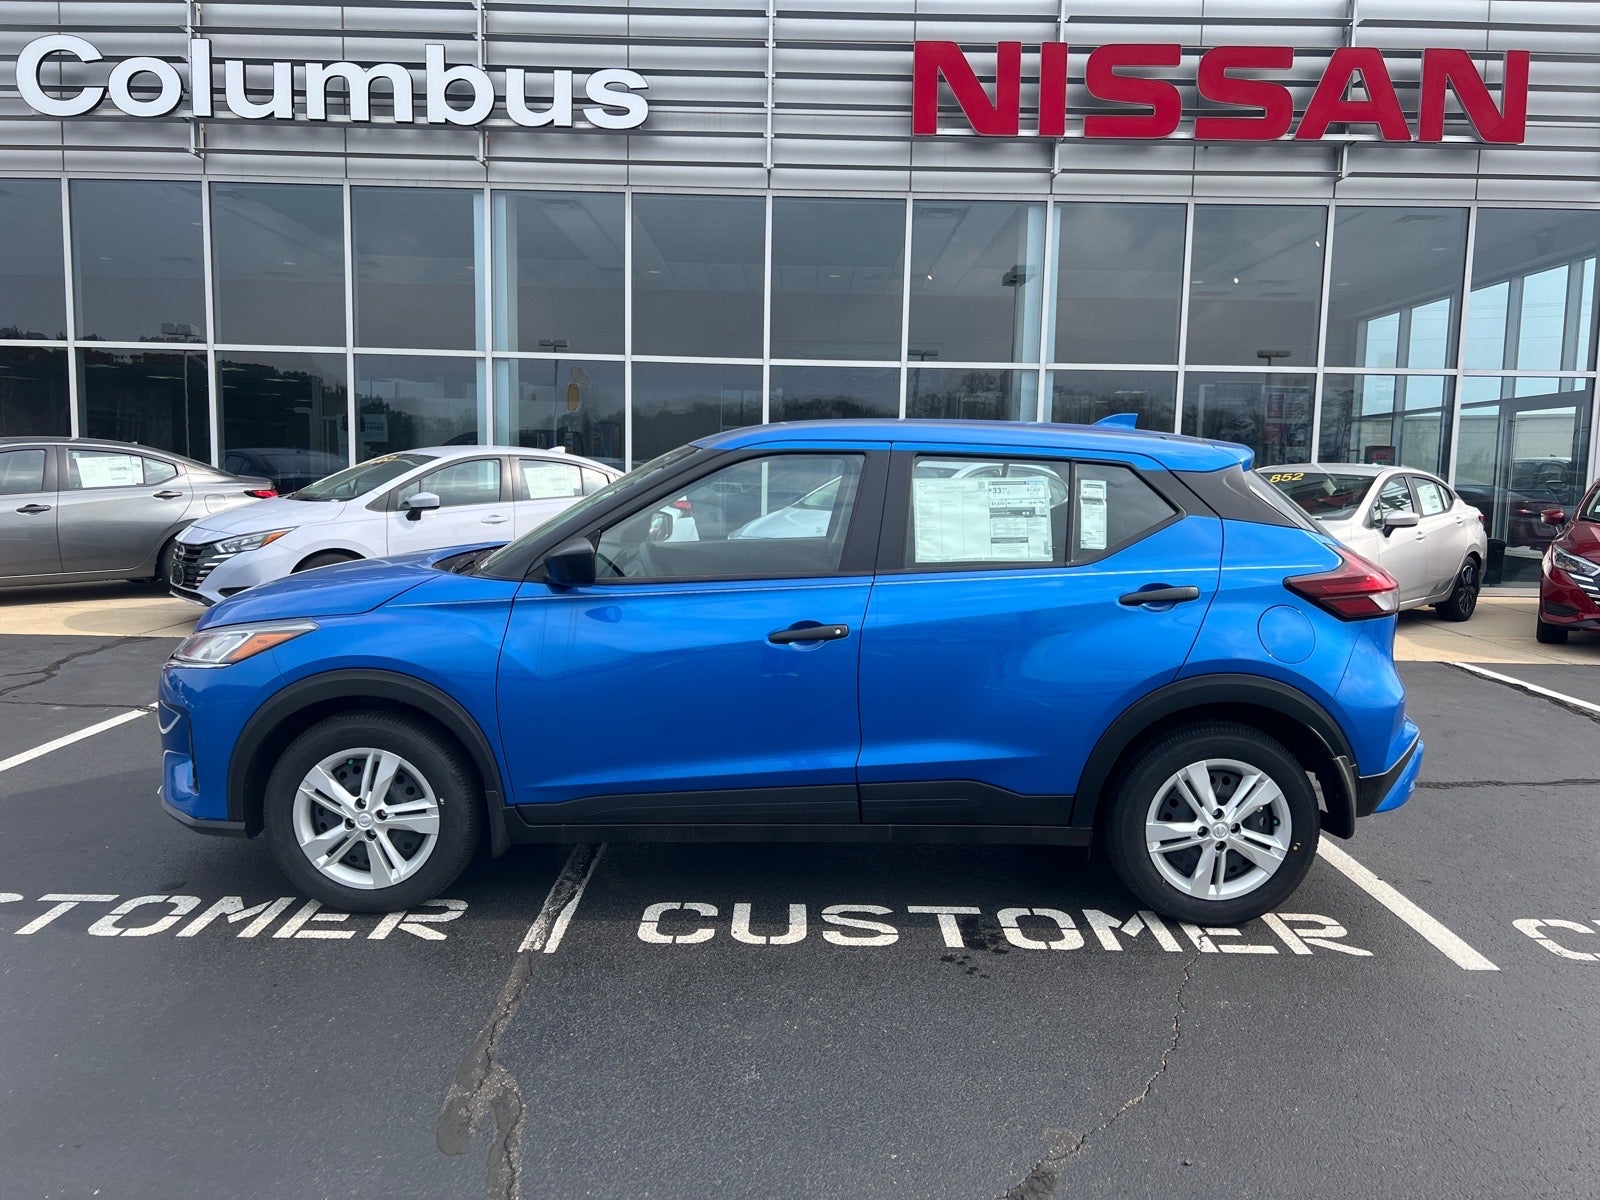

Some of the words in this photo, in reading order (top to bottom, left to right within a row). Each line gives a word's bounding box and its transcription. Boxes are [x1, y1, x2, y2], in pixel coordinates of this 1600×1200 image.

[16, 34, 649, 130] Columbus
[912, 41, 1530, 144] NISSAN
[1269, 472, 1304, 483] 852
[0, 892, 468, 941] TOMER
[637, 902, 1372, 956] CUSTOMER
